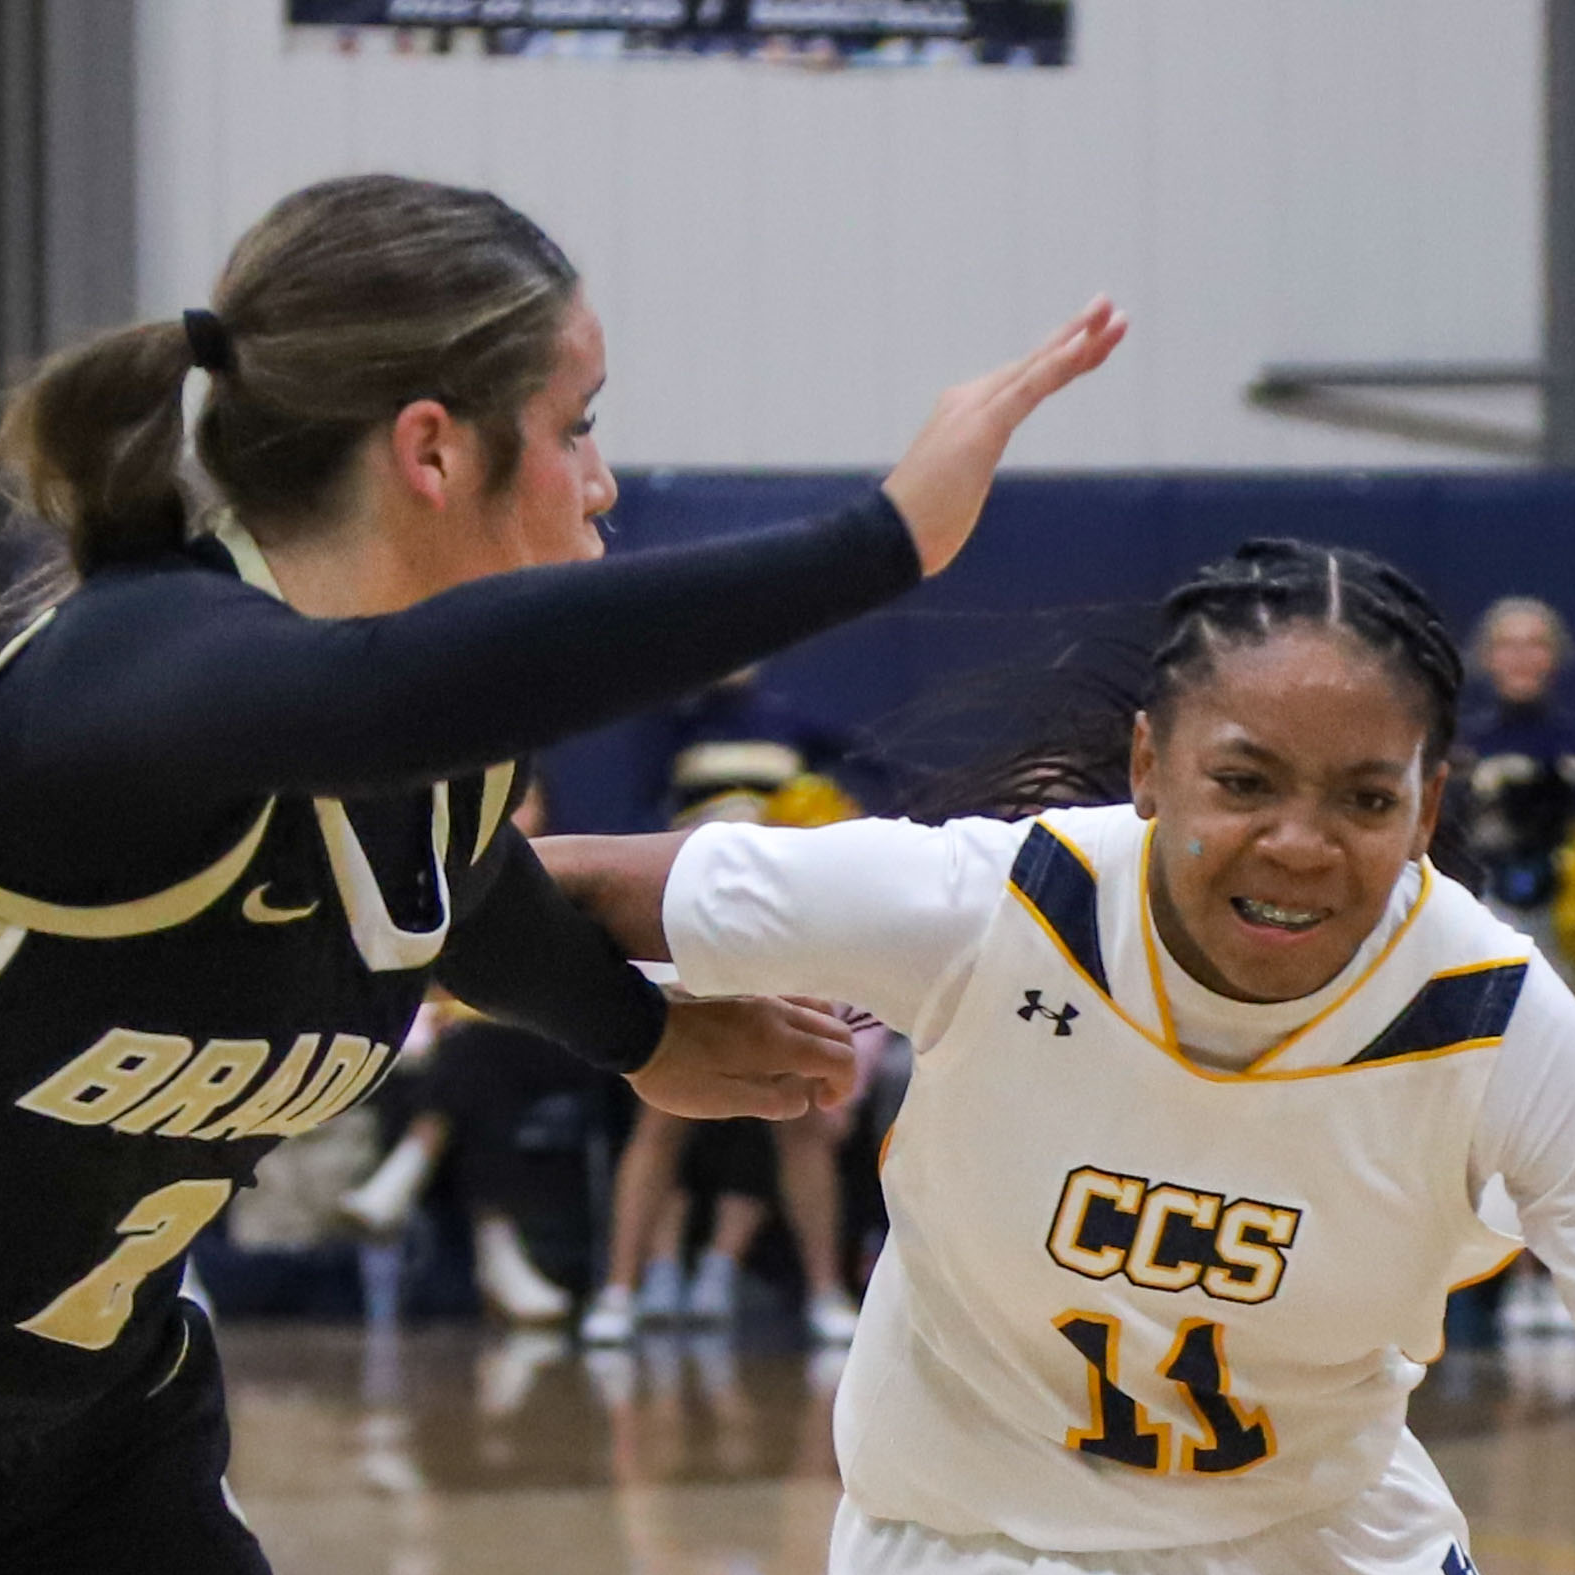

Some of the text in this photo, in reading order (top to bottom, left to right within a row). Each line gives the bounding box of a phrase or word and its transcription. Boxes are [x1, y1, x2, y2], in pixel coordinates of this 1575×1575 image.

[14, 1178, 233, 1352] 2
[1045, 1164, 1303, 1305] CCS
[1050, 1308, 1278, 1477] 11
